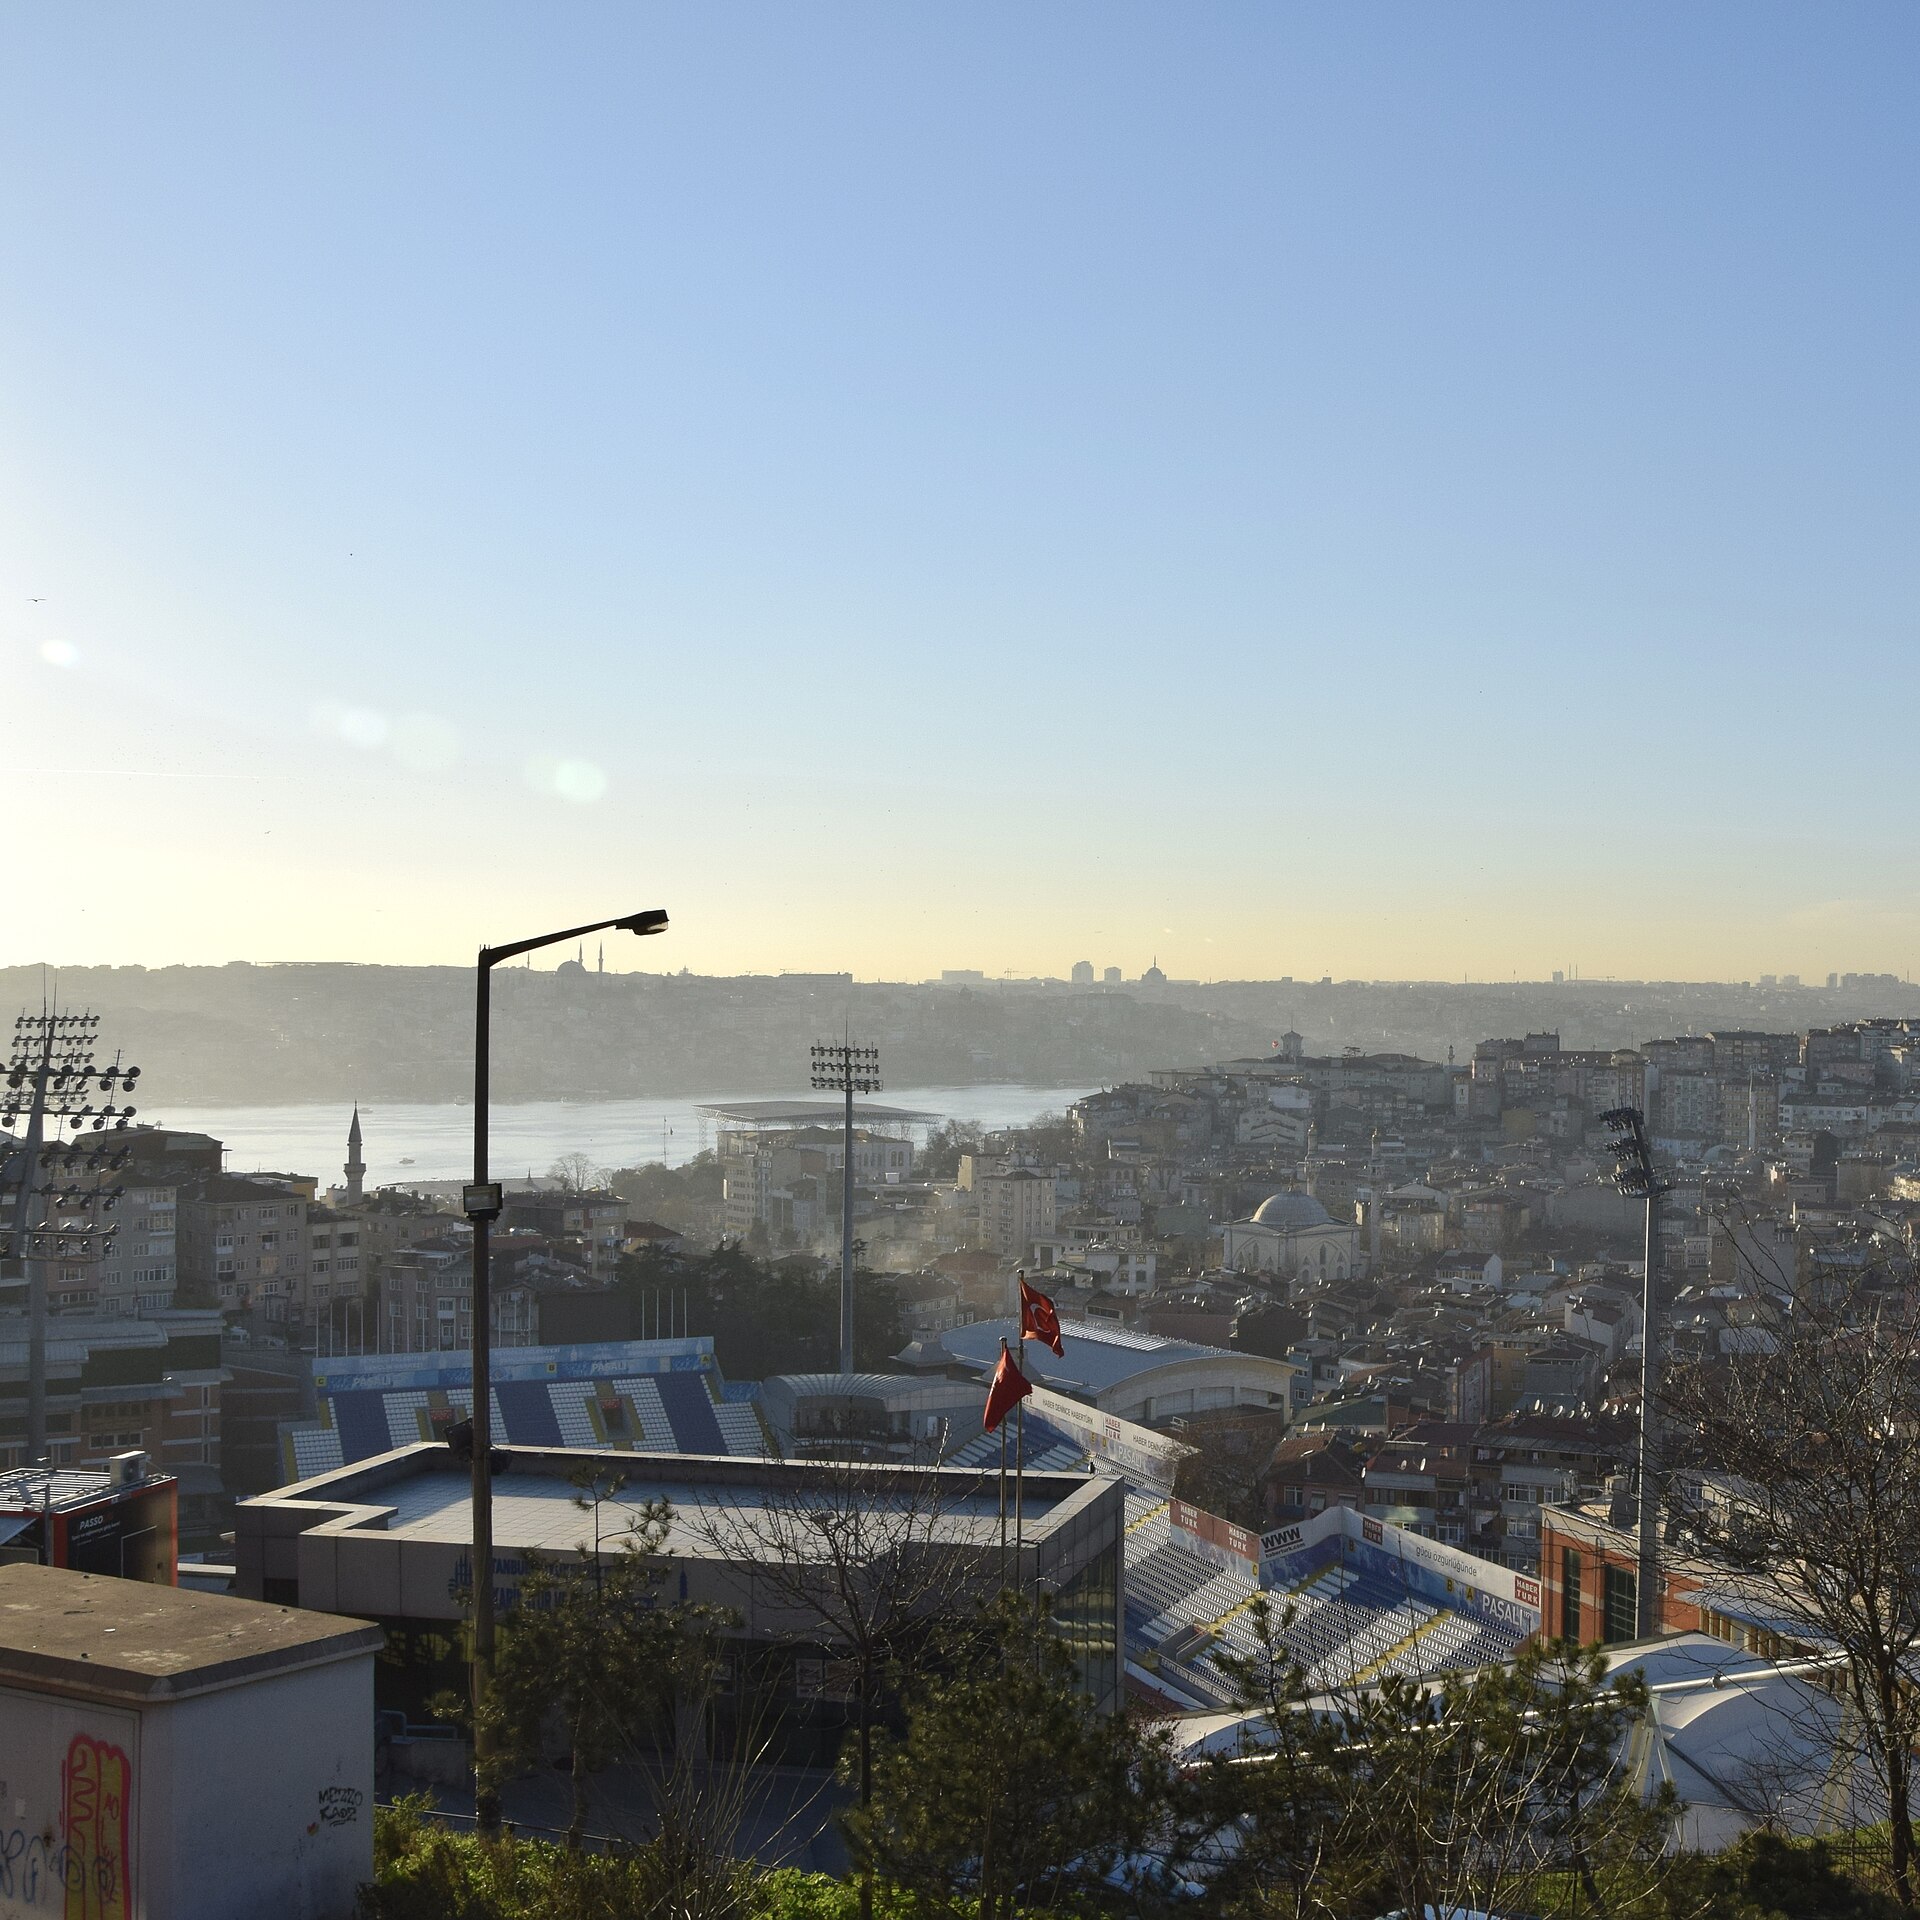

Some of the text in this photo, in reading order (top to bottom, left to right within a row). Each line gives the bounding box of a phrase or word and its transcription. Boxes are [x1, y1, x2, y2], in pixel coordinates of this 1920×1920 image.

[1180, 1504, 1198, 1519] HABER
[79, 1515, 103, 1530] PASSO
[1228, 1526, 1247, 1541] HABER
[1516, 1579, 1538, 1595] HABER
[1516, 1589, 1538, 1605] TURK
[1482, 1594, 1523, 1628] PAŞALI
